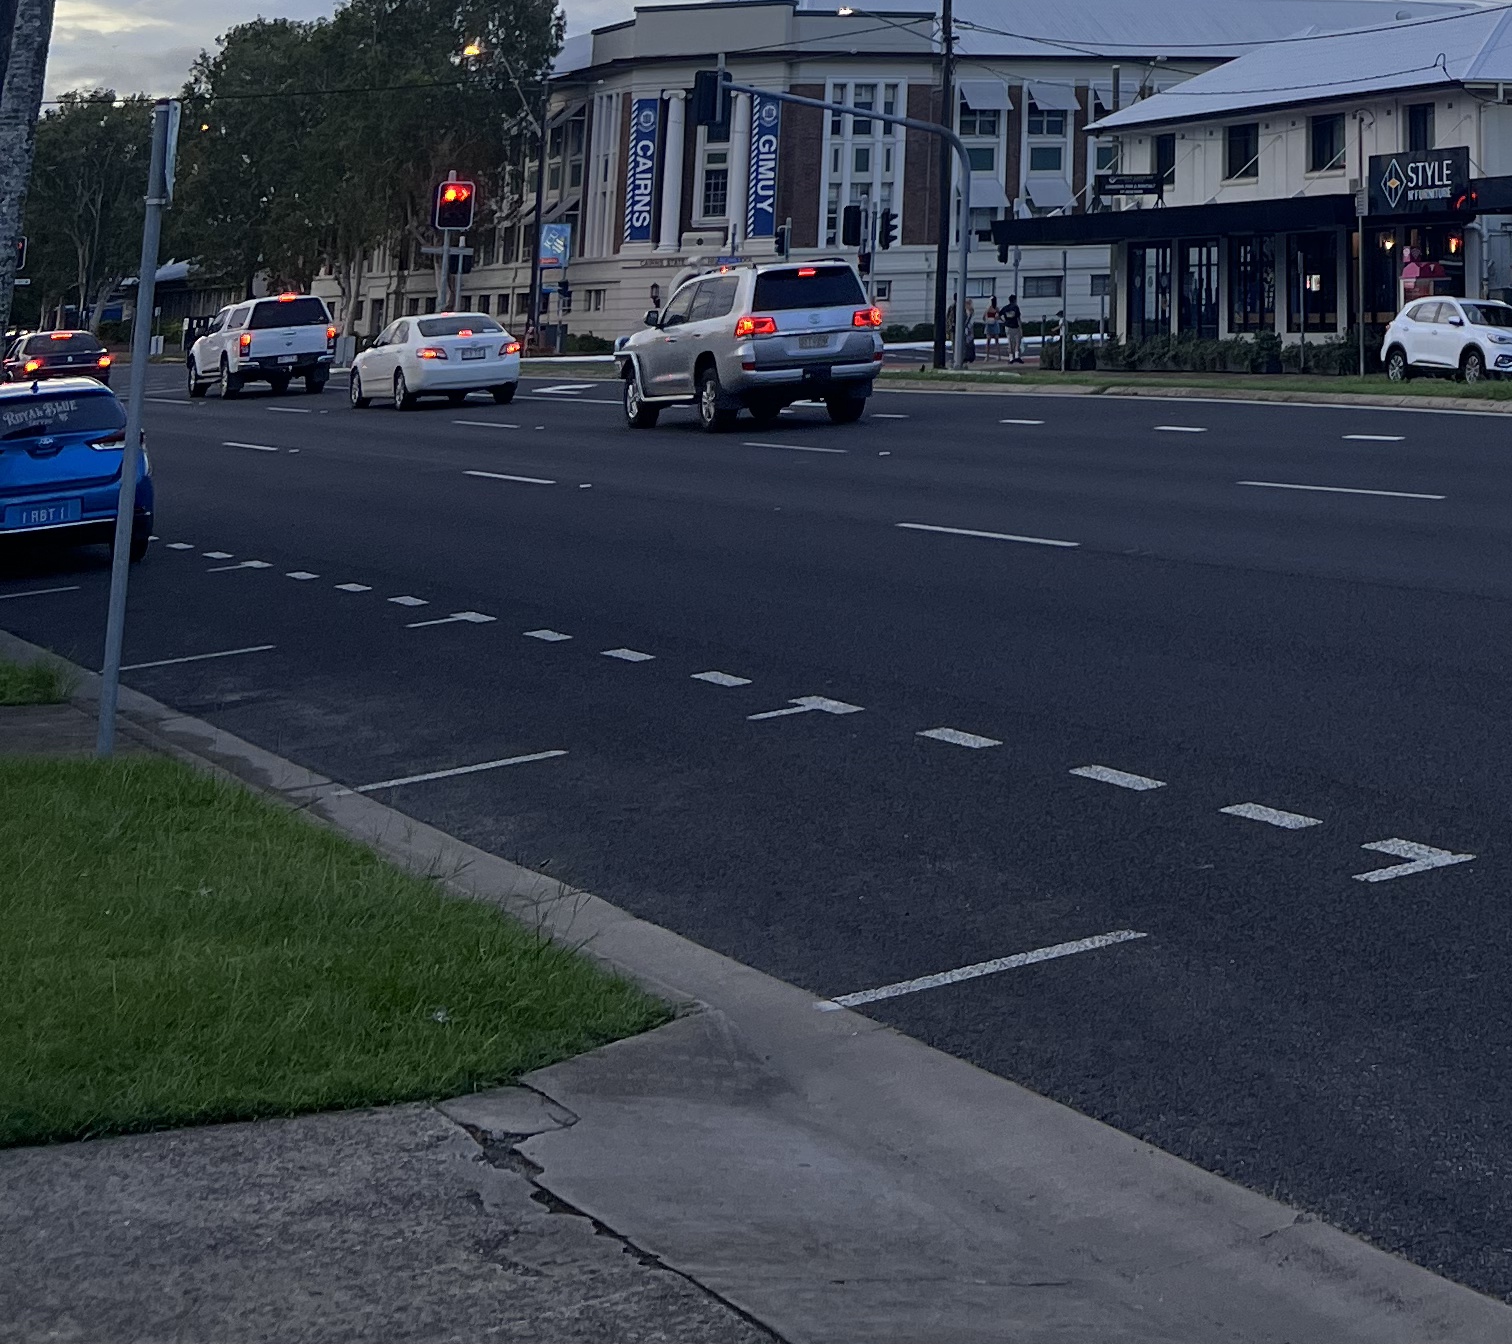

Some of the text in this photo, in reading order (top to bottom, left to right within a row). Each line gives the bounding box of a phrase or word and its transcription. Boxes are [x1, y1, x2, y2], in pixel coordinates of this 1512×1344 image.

[632, 139, 655, 228] CAIRNS
[756, 134, 777, 213] GIMUY
[1407, 160, 1453, 187] STYLE
